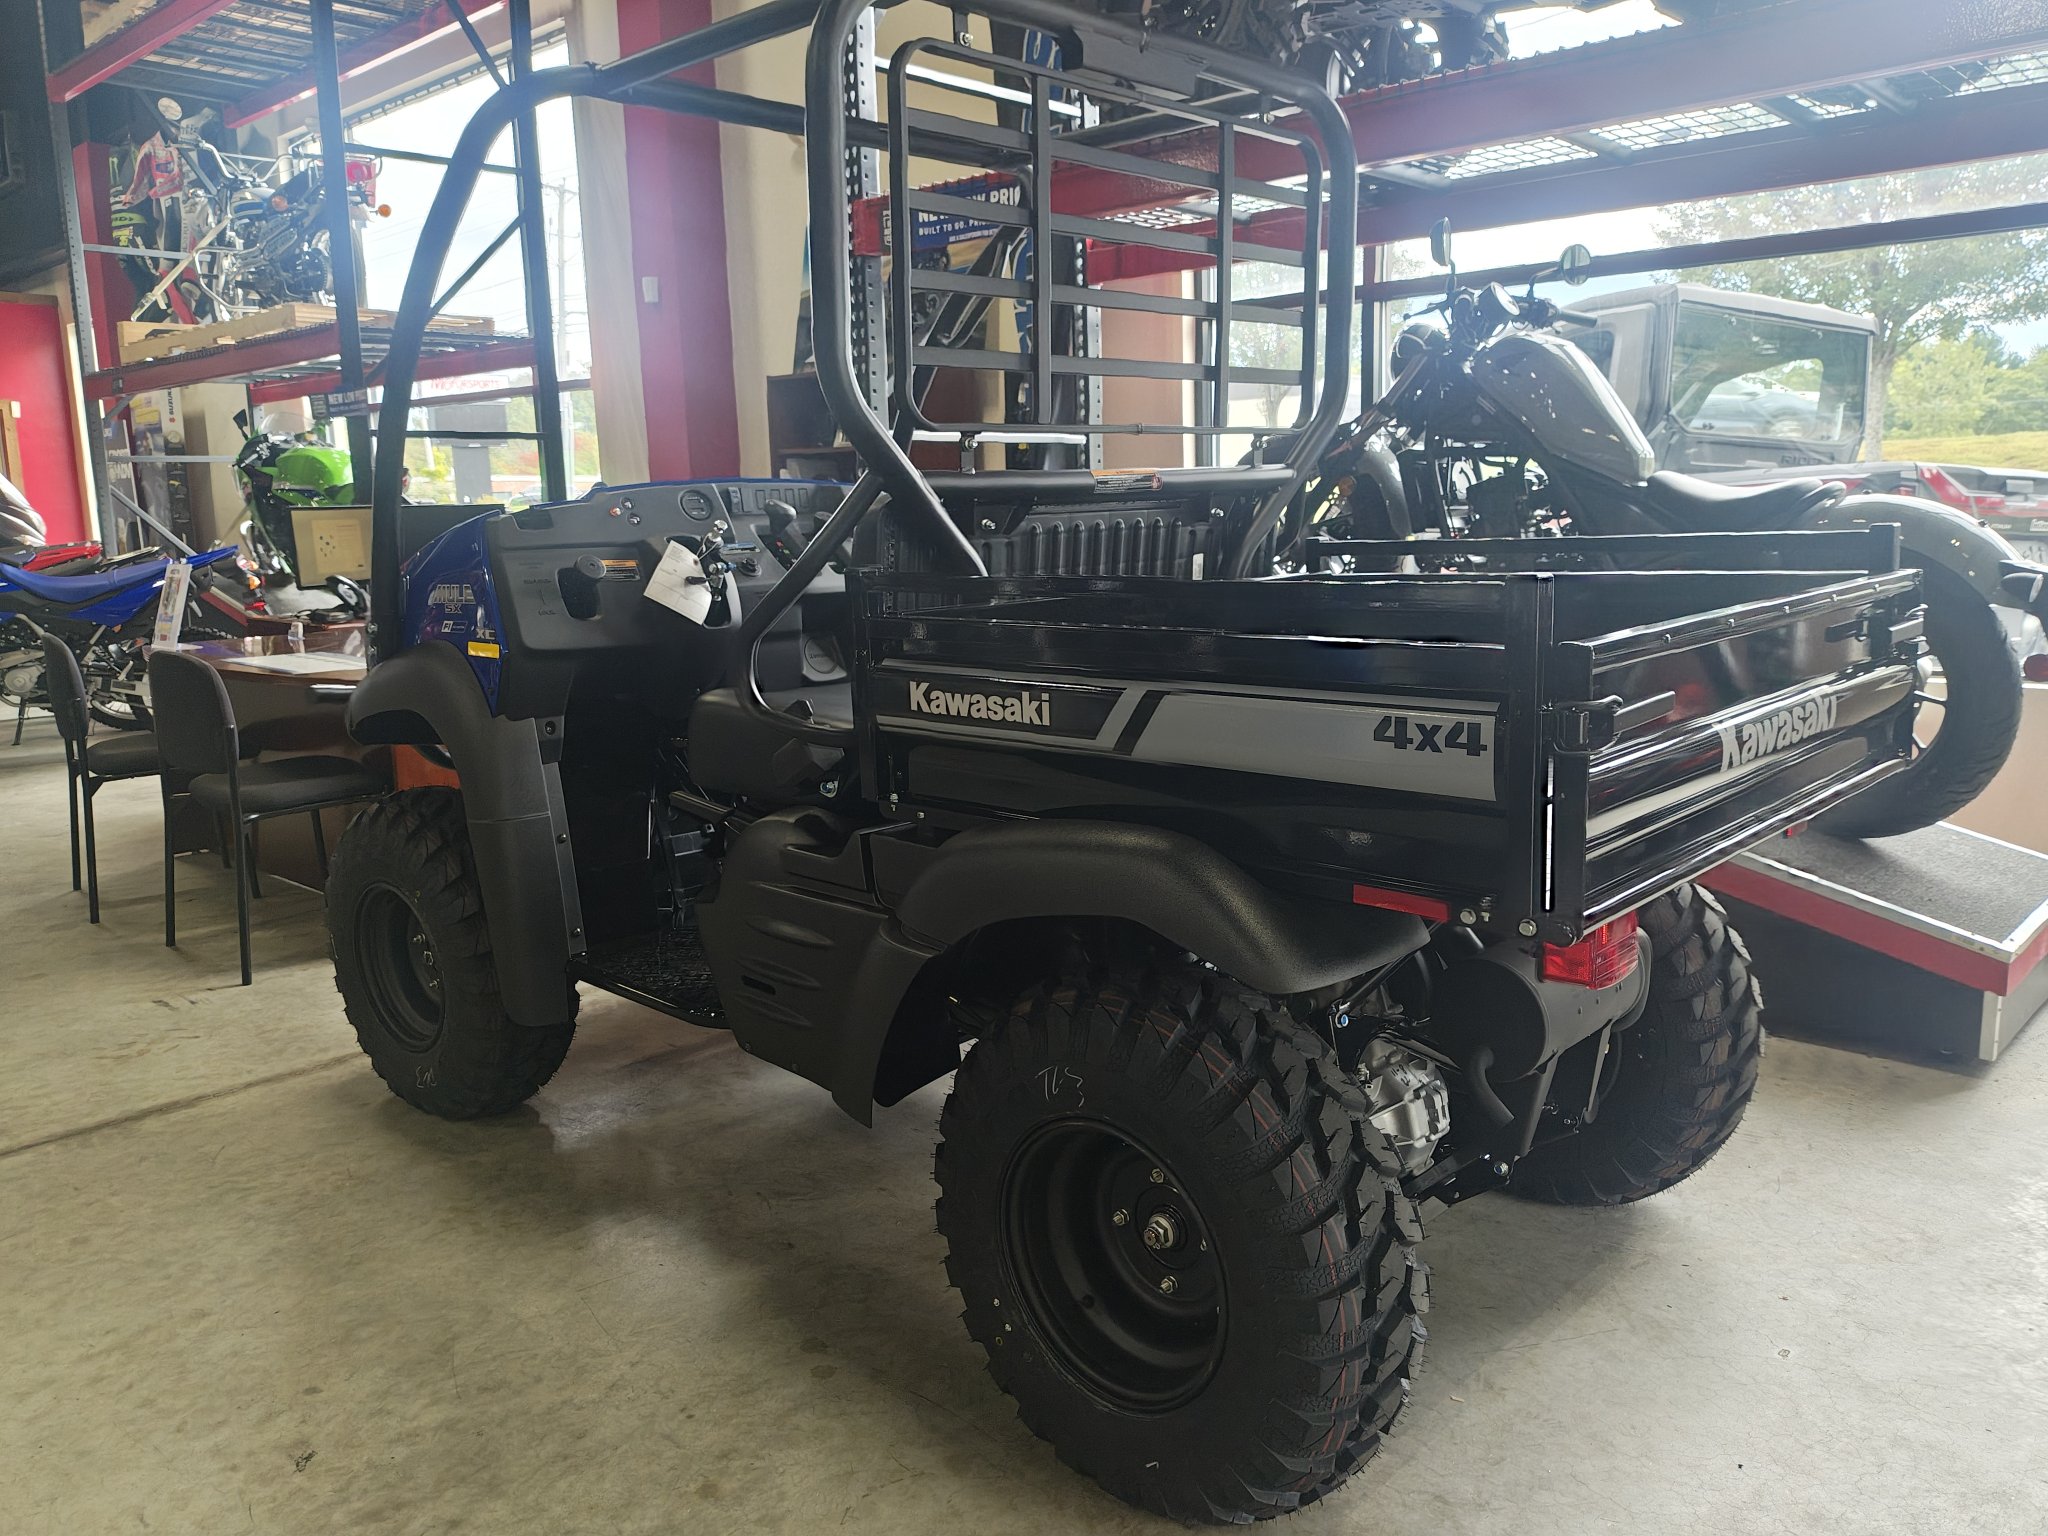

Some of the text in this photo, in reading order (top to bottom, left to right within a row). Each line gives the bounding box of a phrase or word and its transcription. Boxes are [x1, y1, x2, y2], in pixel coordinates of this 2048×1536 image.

[918, 225, 941, 236] BUILT
[943, 223, 952, 232] TO
[167, 388, 175, 416] SUZUK
[428, 584, 476, 605] MULE
[909, 680, 1051, 726] Kawasaki
[1373, 715, 1488, 757] 4x4
[1714, 692, 1839, 773] Kawasaki
